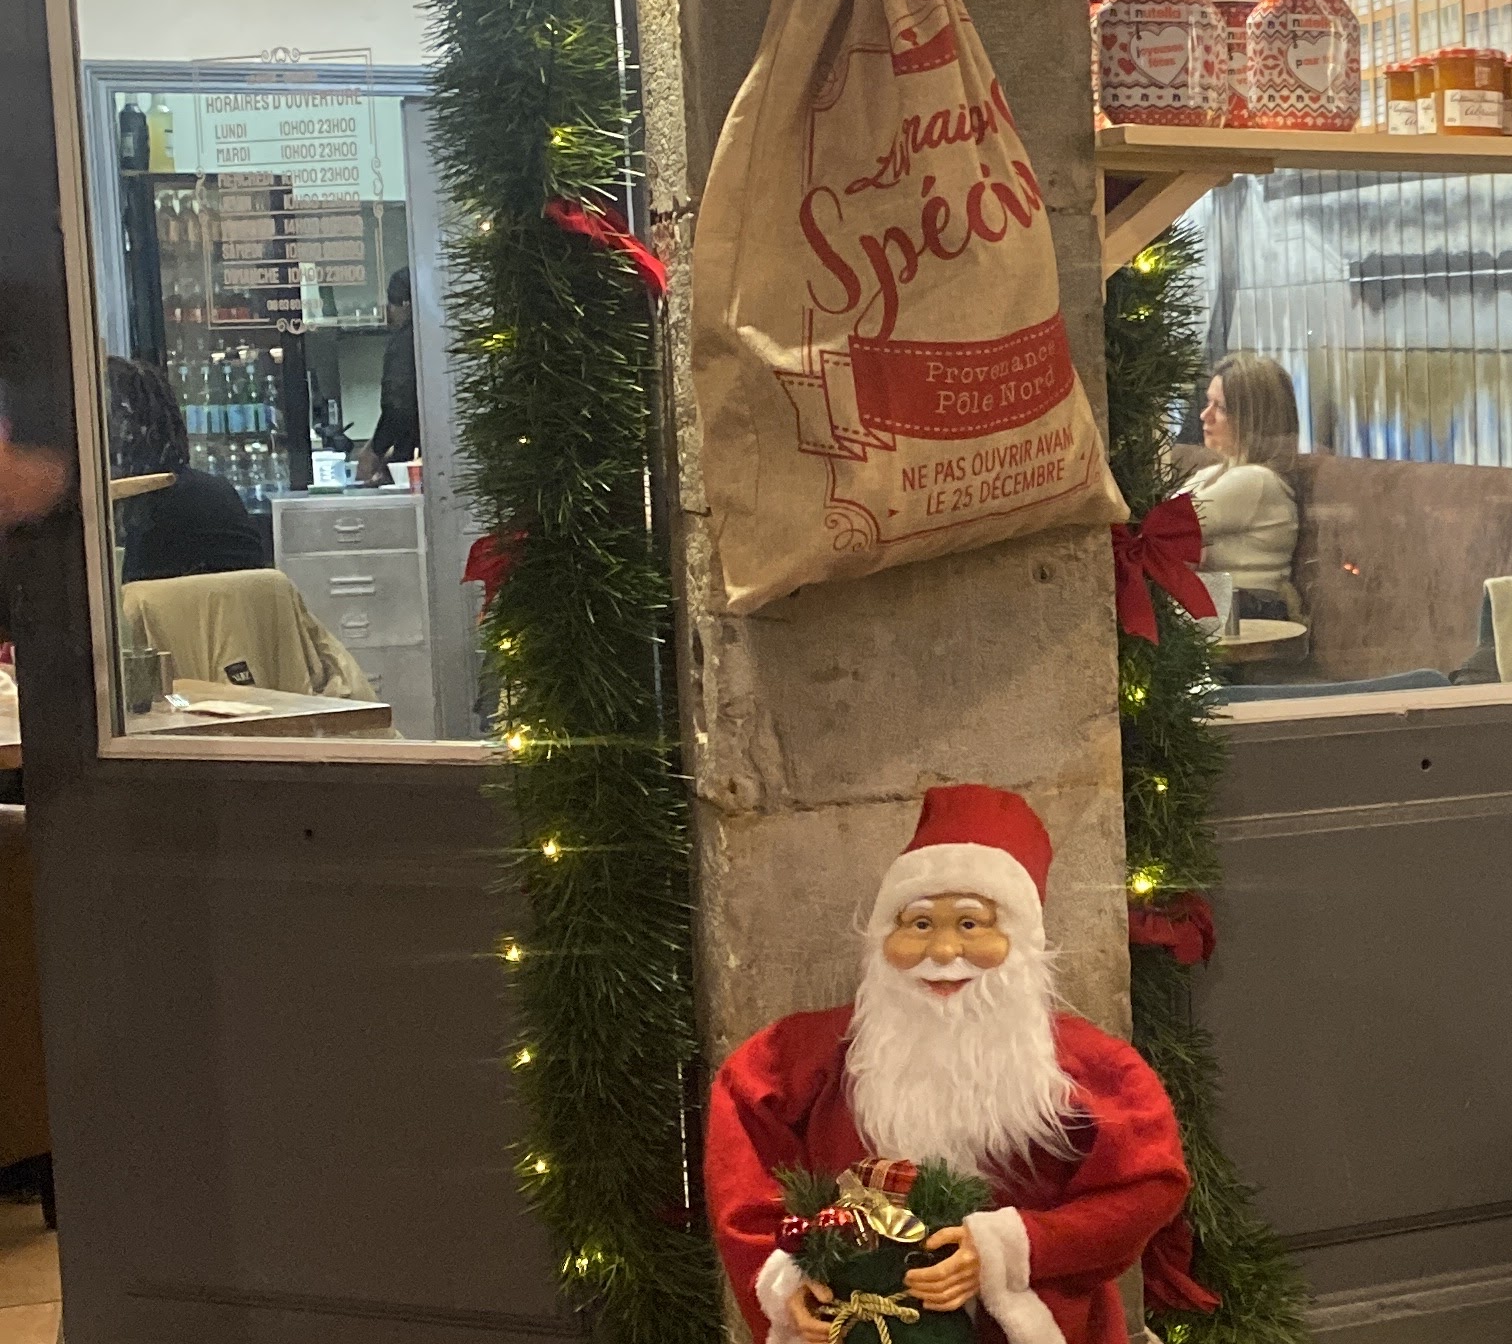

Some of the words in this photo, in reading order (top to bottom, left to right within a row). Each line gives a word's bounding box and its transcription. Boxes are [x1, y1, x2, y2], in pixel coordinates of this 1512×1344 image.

[206, 94, 269, 113] HORAIRES
[215, 123, 247, 139] LUNDI
[280, 120, 315, 136] 10H00
[317, 117, 356, 134] 23H00
[216, 147, 250, 163] MARDI
[281, 143, 316, 160] 10H00
[319, 141, 358, 159] 23H00
[320, 166, 359, 183] 23H00
[926, 340, 1056, 384] Provenance
[935, 390, 994, 416] Pôle
[999, 364, 1055, 408] Nord
[902, 464, 928, 492] NE
[934, 456, 966, 486] PAS
[971, 439, 1033, 477] OUVRIR
[926, 491, 946, 516] LE
[951, 487, 973, 511] 25
[979, 457, 1065, 504] DÉCEMBRE
